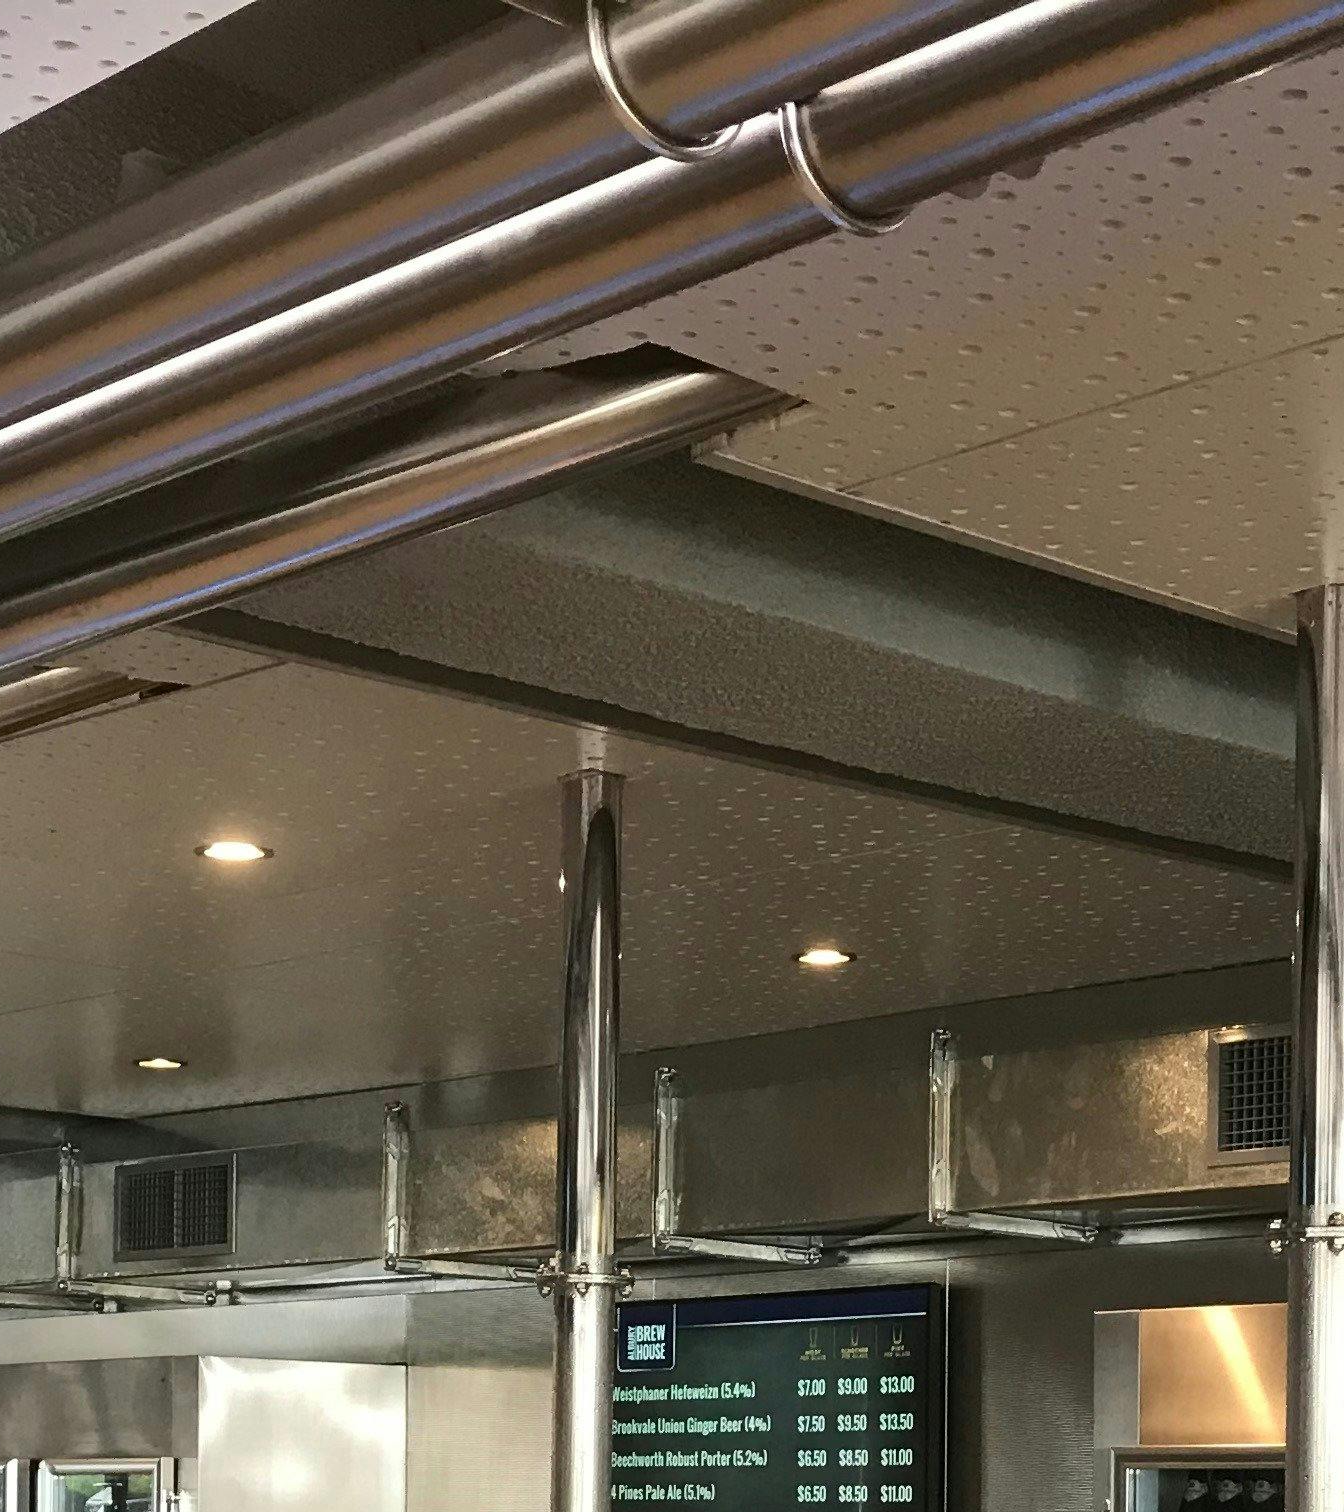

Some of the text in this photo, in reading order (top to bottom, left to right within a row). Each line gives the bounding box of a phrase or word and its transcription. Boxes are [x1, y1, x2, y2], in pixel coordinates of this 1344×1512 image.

[636, 1324, 666, 1342] BREW
[636, 1342, 666, 1361] HOUSE
[720, 1381, 756, 1399] (5.4%)
[797, 1378, 826, 1397] $7.00
[837, 1377, 868, 1395] $9.00
[879, 1375, 915, 1394] $13.00
[611, 1412, 914, 1436] Brookvale Union Ginger Beer (4%) $7.50 $9.50 $13.50
[665, 1450, 699, 1467] Robust
[700, 1450, 732, 1467] Porter
[732, 1449, 768, 1467] (5.2%)
[797, 1449, 827, 1467] $6.50
[838, 1448, 869, 1467] $8.50
[880, 1448, 913, 1467] $11.00
[618, 1484, 643, 1500] Pines
[645, 1484, 666, 1500] Pale
[667, 1484, 682, 1500] Ale
[683, 1483, 716, 1501] (5.1%)
[797, 1485, 827, 1503] $6.50
[838, 1484, 868, 1503] $8.50
[880, 1484, 913, 1503] $11.00
